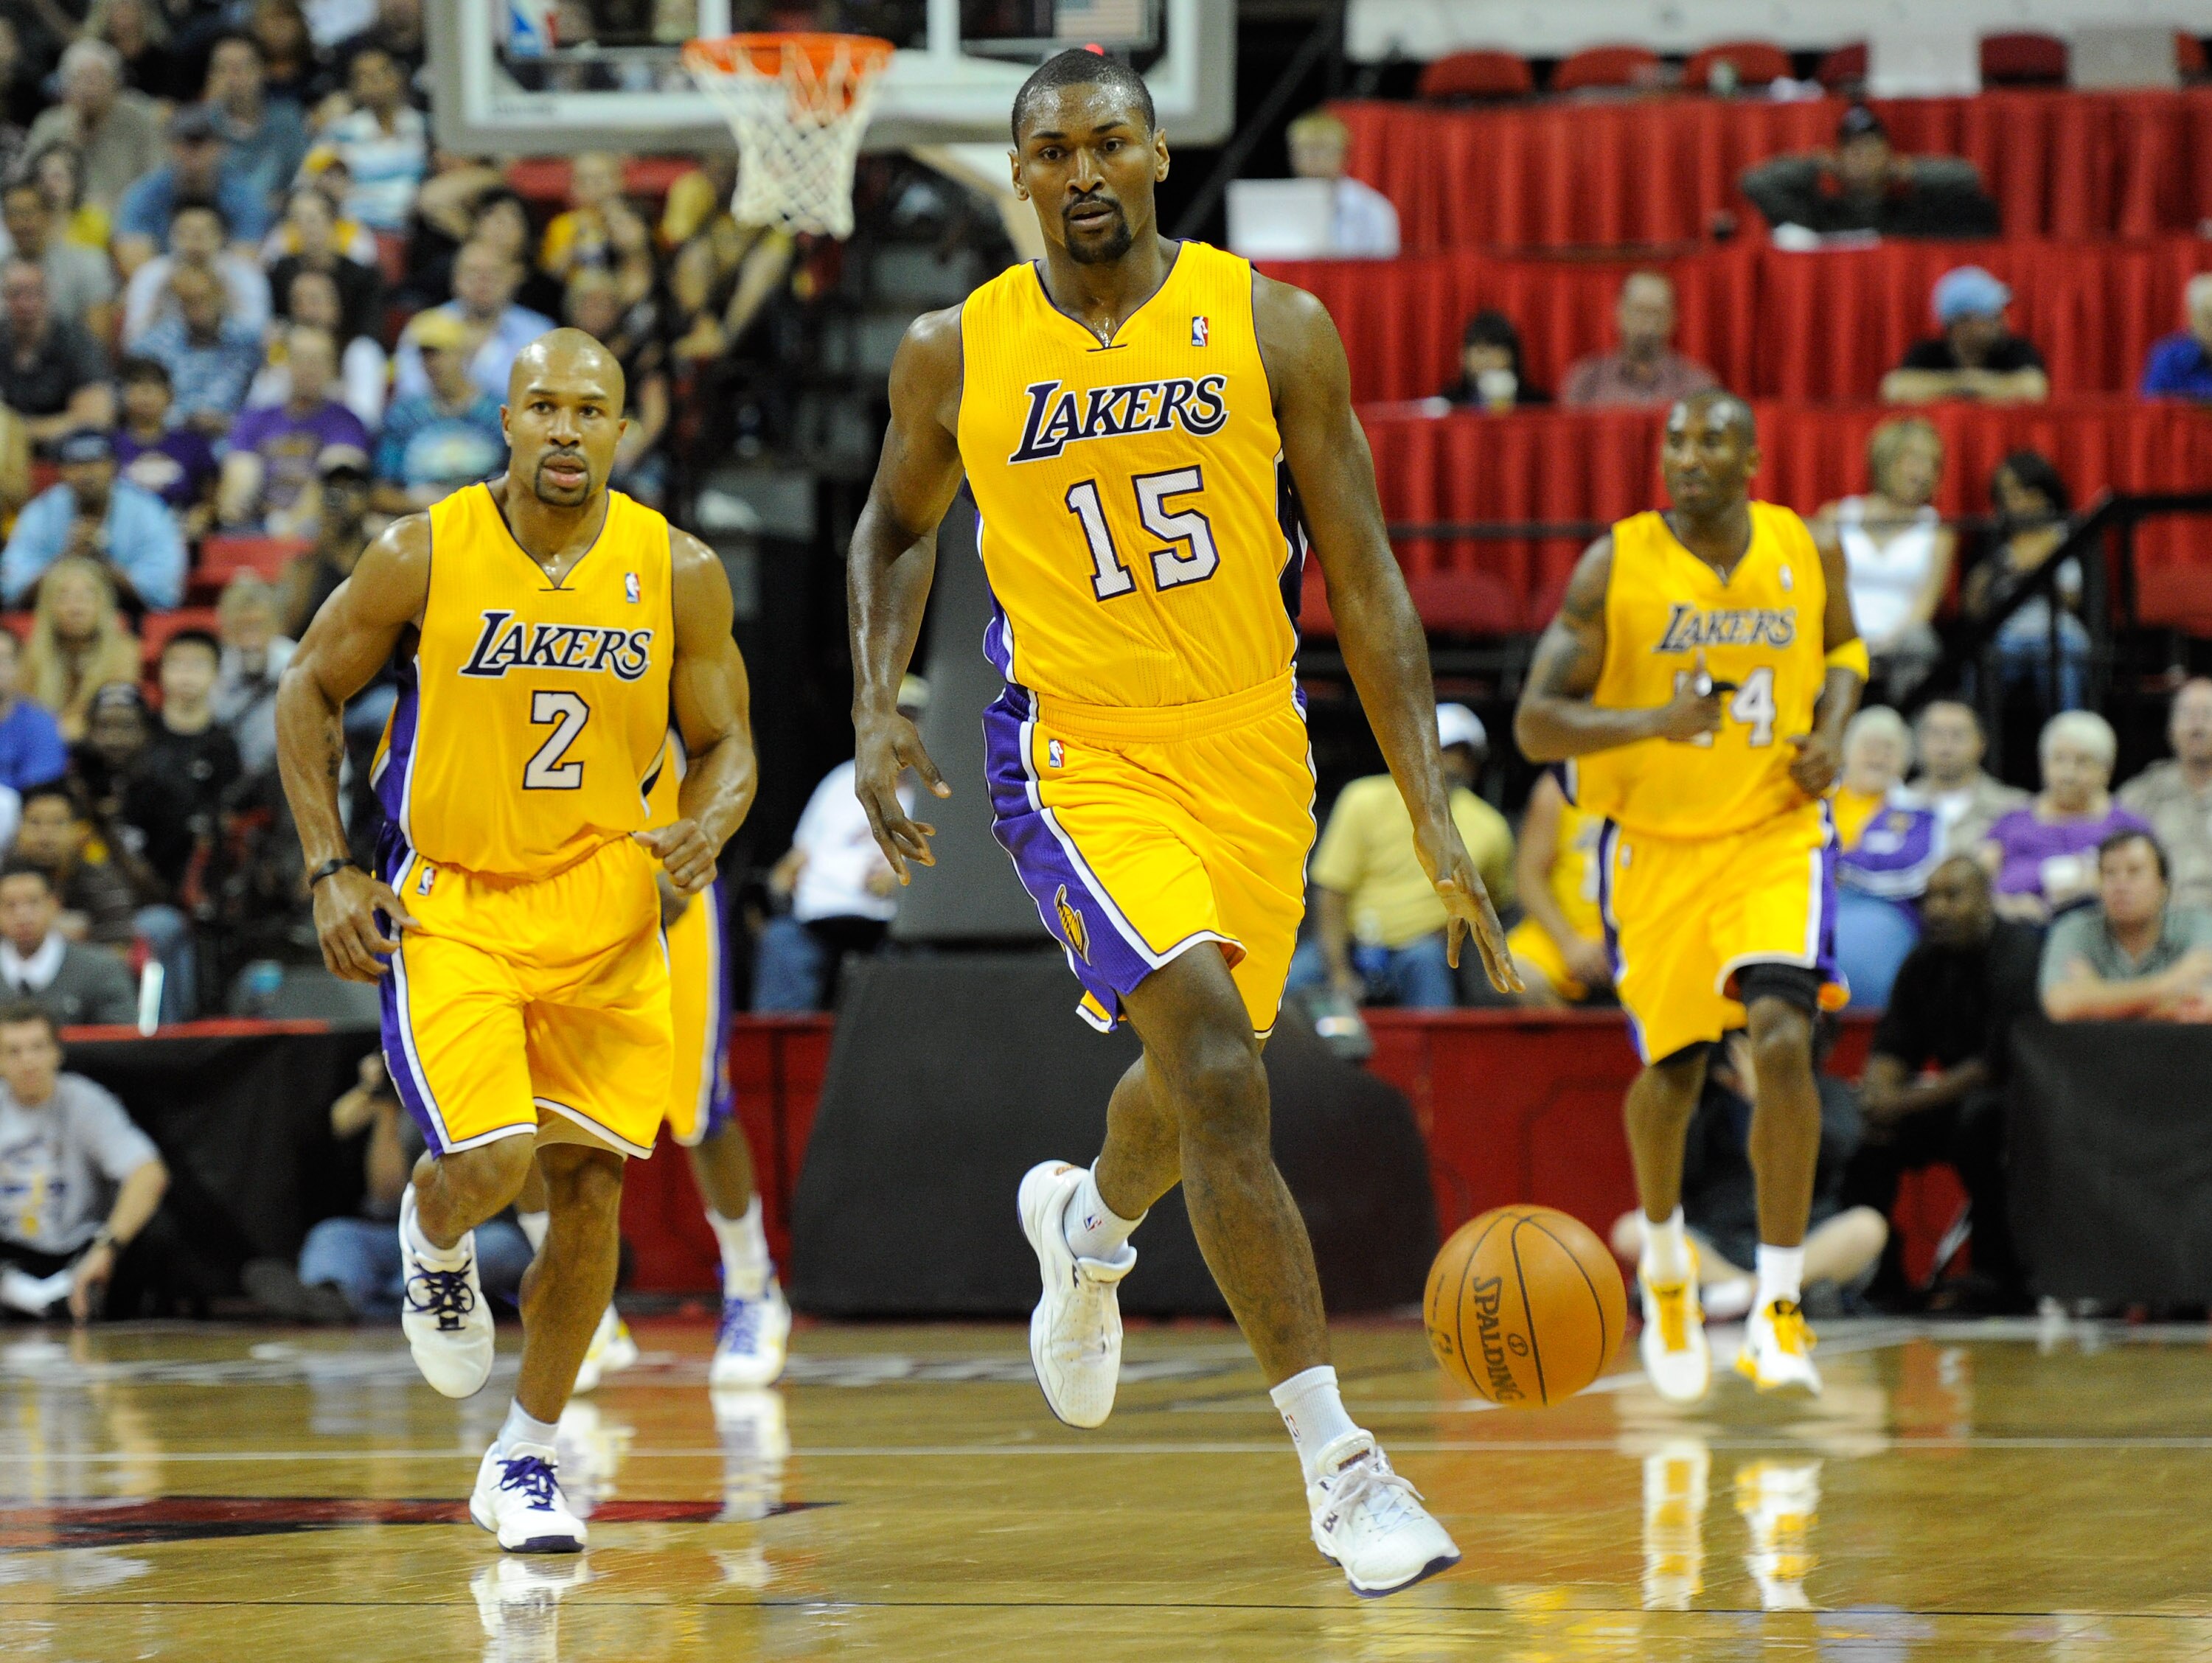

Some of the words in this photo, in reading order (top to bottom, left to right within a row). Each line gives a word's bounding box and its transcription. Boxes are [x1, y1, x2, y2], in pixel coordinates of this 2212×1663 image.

[1007, 374, 1230, 465] LAKERS
[1065, 464, 1220, 602] 15
[458, 610, 654, 682] LAKERS
[1652, 601, 1798, 653] LAKERS
[522, 690, 590, 789] 2
[1674, 666, 1775, 747] 4
[1473, 1276, 1526, 1400] SPALDING
